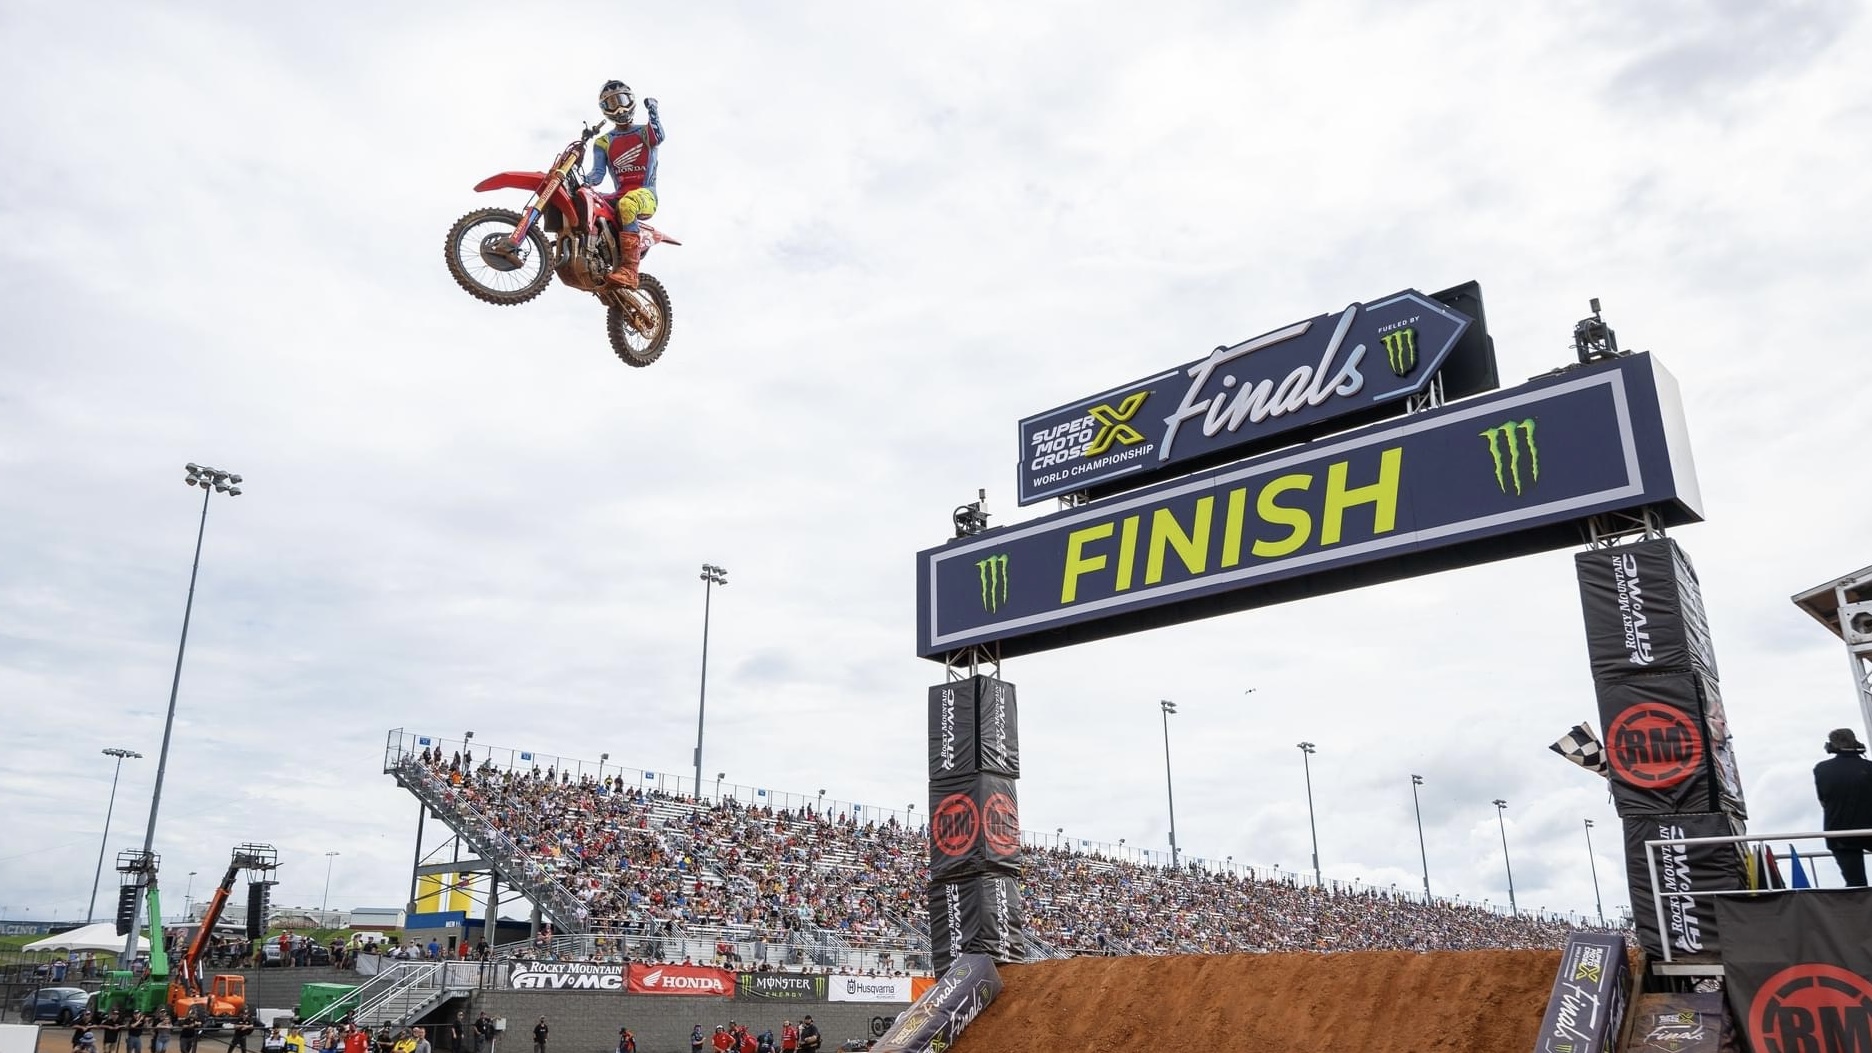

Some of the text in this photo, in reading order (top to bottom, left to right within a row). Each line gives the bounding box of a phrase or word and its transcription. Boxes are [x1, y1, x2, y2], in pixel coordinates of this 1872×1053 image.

[1378, 315, 1420, 334] FUELED BY
[1159, 305, 1367, 461] Finals
[1031, 415, 1096, 446] SUPER
[1035, 429, 1093, 457] MOTO
[1031, 441, 1094, 471] CROSS
[1033, 444, 1154, 487] WORLD CHAMPIONSHIP
[1061, 446, 1403, 603] FINISH
[1612, 555, 1637, 649] ROCKY MOUNTAIN
[1659, 825, 1680, 891] MOUNTIN
[529, 961, 622, 974] ROCKY MOUNTAIN
[662, 976, 724, 990] HONDA
[756, 976, 811, 990] MONSTER
[856, 982, 895, 996] Husqvarna
[921, 977, 962, 1017] Finals
[1553, 982, 1601, 1041] Finals
[1643, 1025, 1706, 1043] Finals
